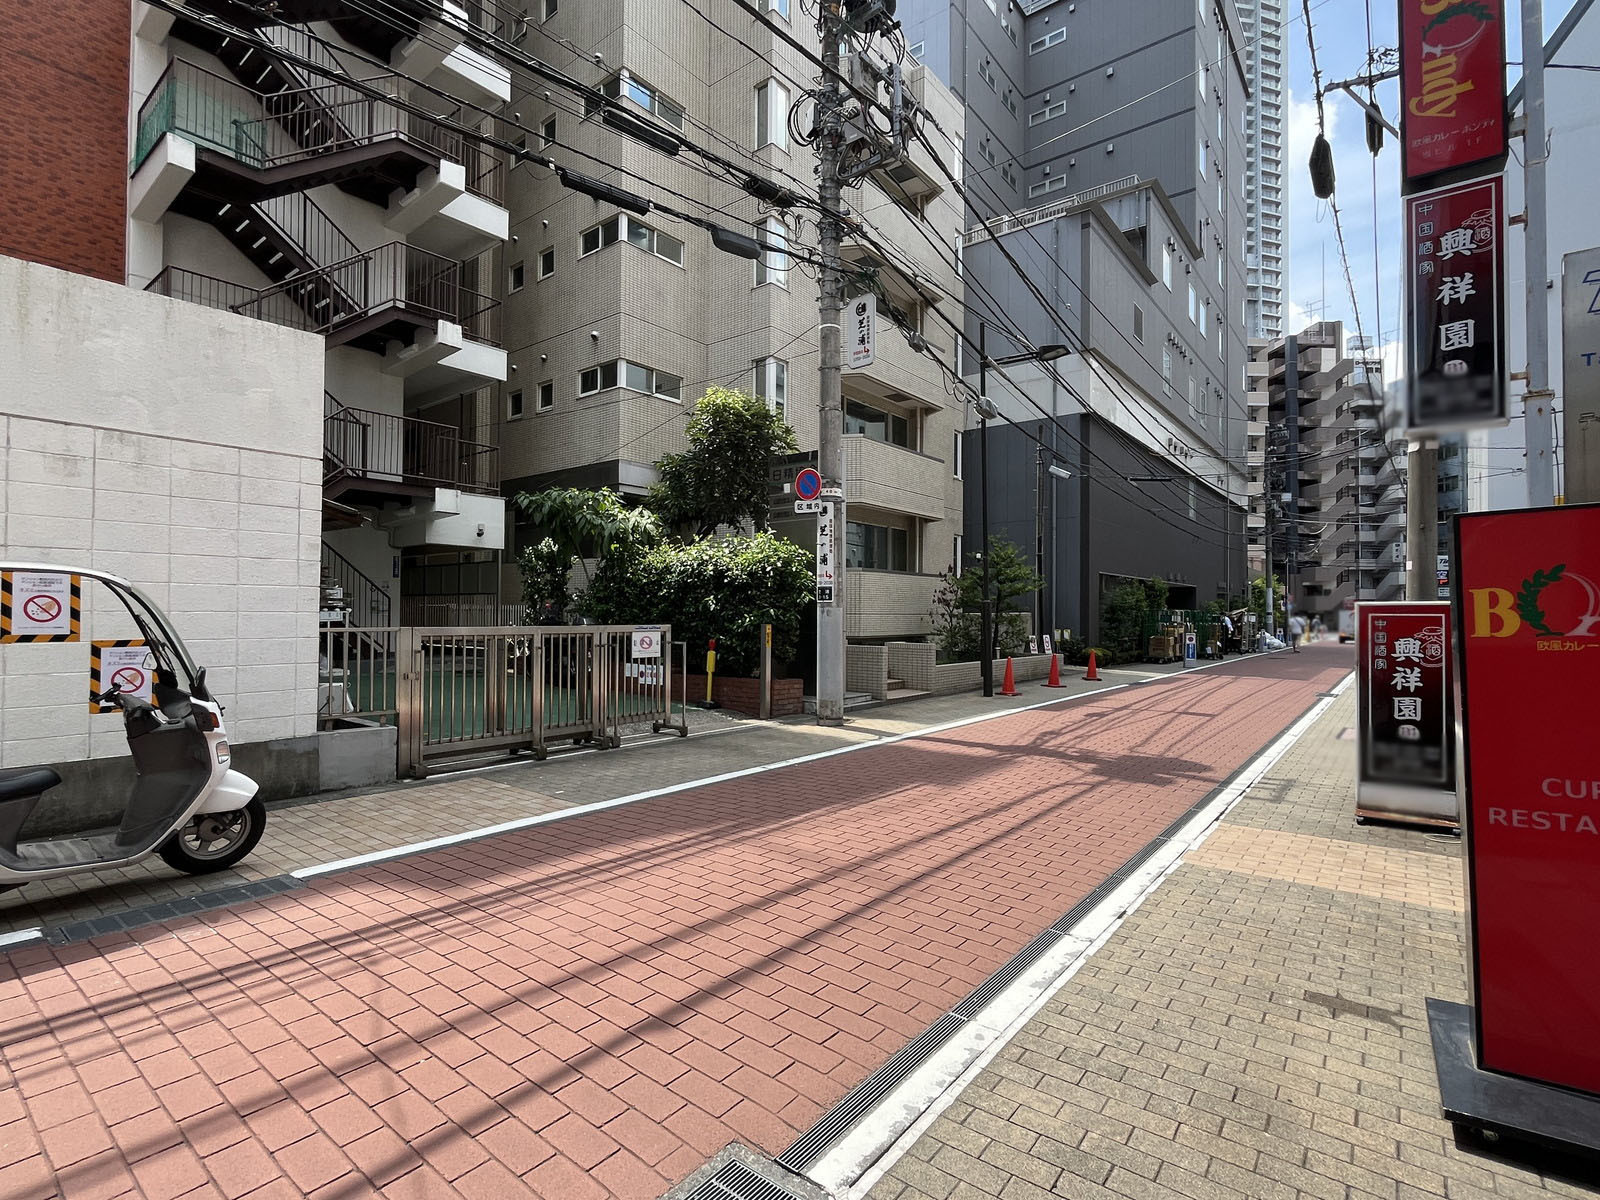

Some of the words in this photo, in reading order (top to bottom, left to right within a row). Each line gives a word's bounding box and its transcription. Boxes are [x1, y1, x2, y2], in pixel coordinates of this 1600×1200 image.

[1436, 227, 1477, 351] 興祥園
[796, 502, 820, 511] 区域内
[1390, 637, 1424, 722] 興祥園
